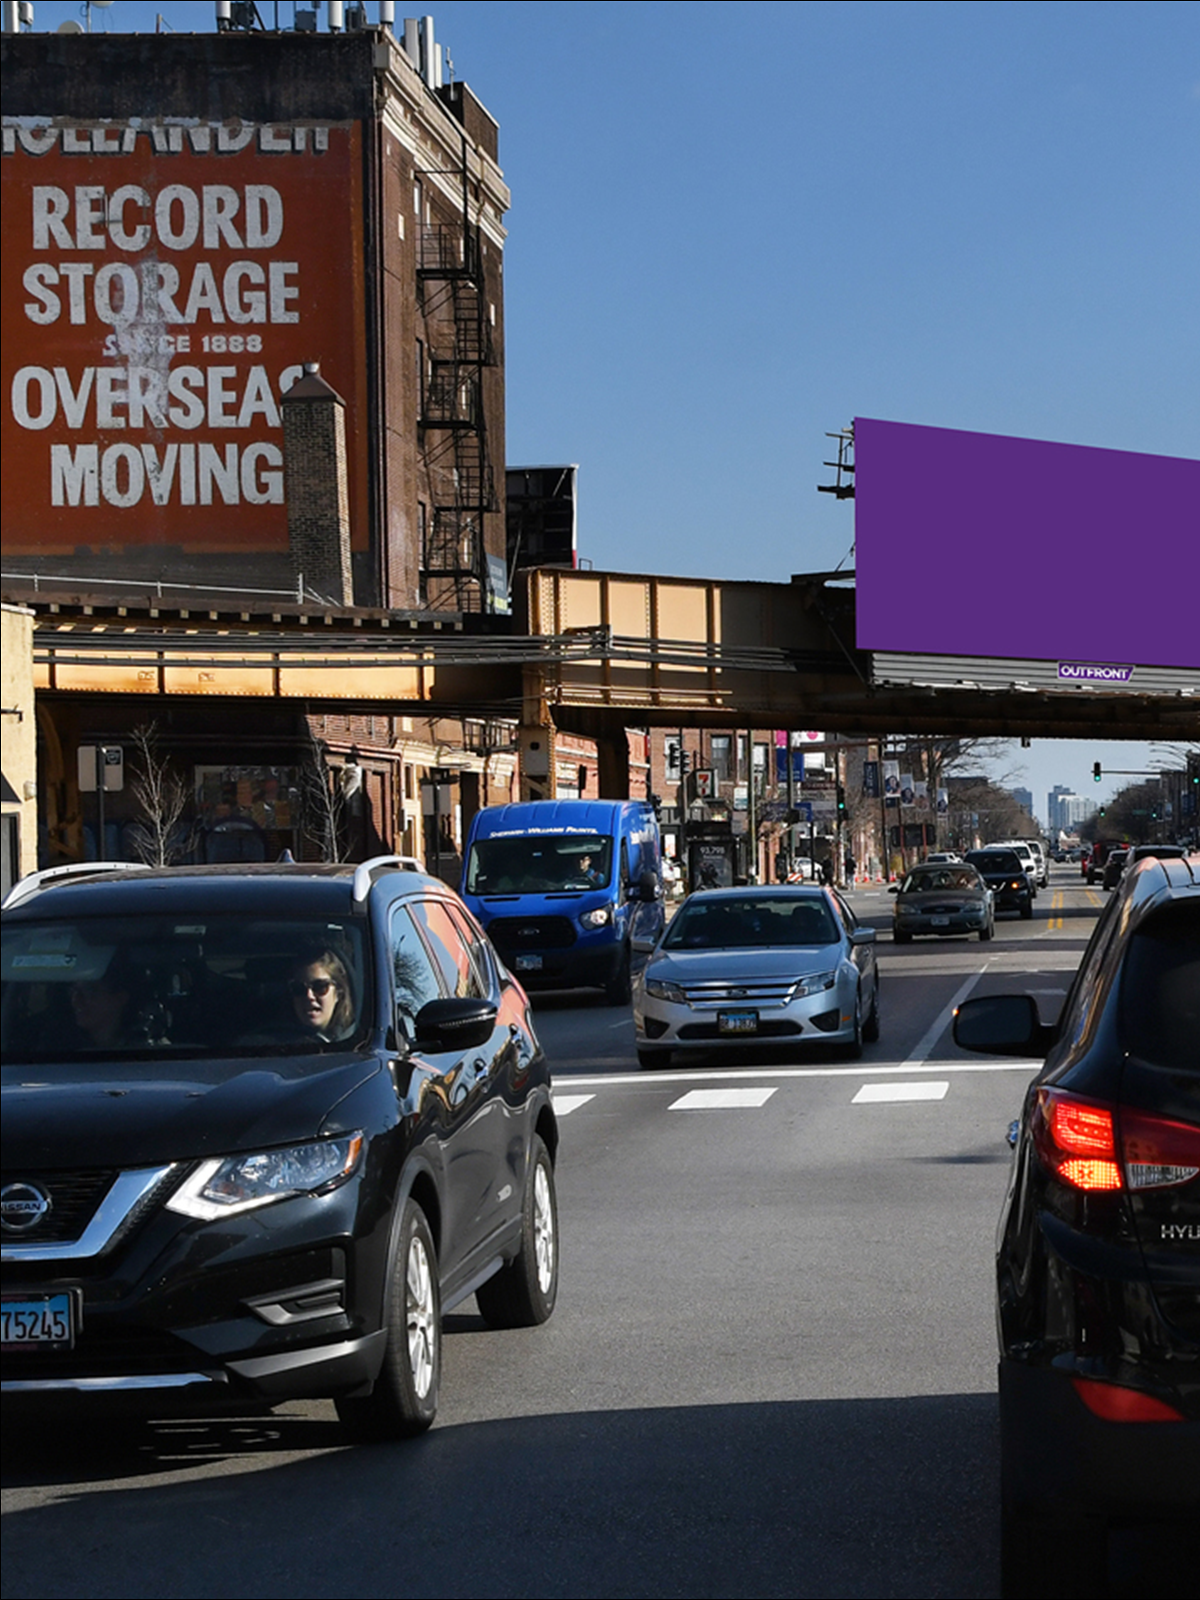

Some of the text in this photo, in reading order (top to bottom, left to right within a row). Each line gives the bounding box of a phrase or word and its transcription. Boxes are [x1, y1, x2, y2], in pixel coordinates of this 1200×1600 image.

[32, 184, 284, 251] RECORD
[22, 261, 300, 325] STORAGE
[102, 334, 263, 356] SCE 1888
[50, 442, 285, 508] MOVING
[1060, 665, 1129, 679] OUTFRONT
[1, 1310, 66, 1341] 75245
